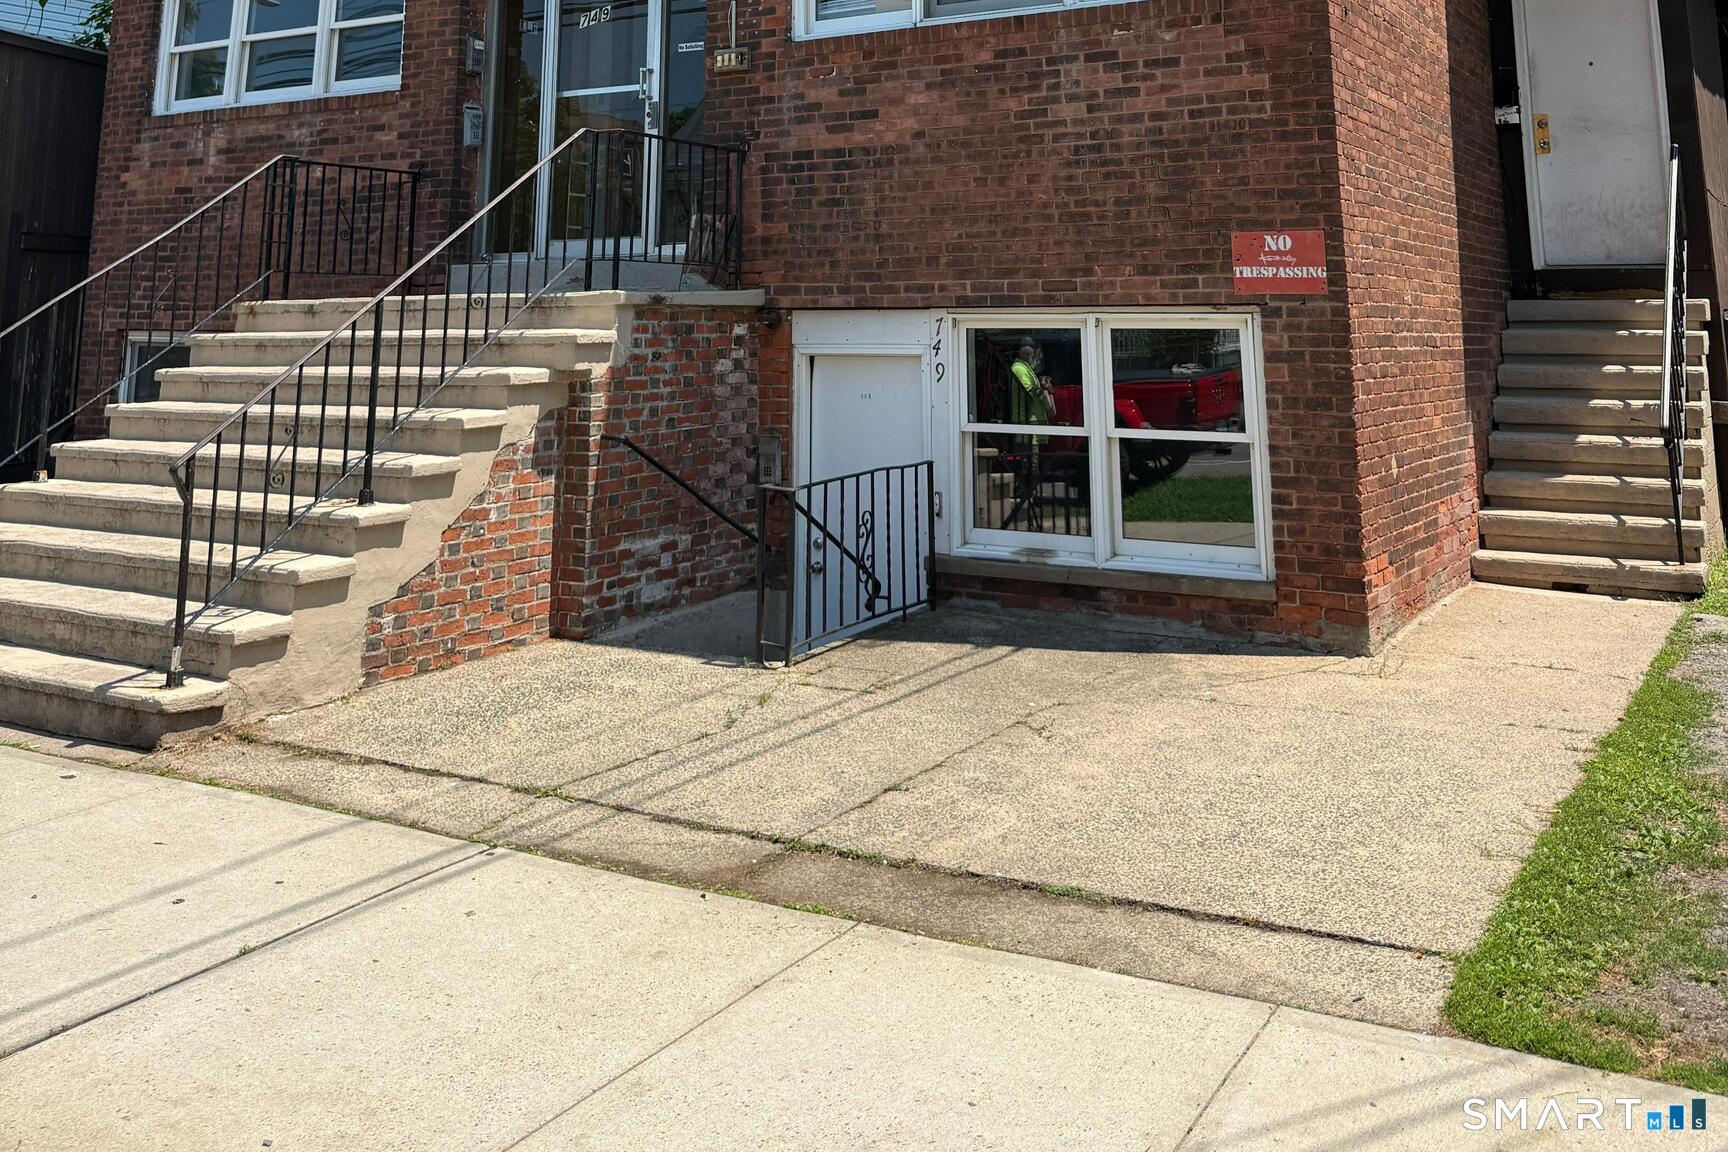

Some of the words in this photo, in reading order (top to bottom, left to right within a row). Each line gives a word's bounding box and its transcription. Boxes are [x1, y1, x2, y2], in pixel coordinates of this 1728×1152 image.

[580, 7, 610, 27] 749
[1263, 235, 1292, 251] NO
[1233, 266, 1327, 278] TRESPASSING
[932, 317, 945, 383] 749
